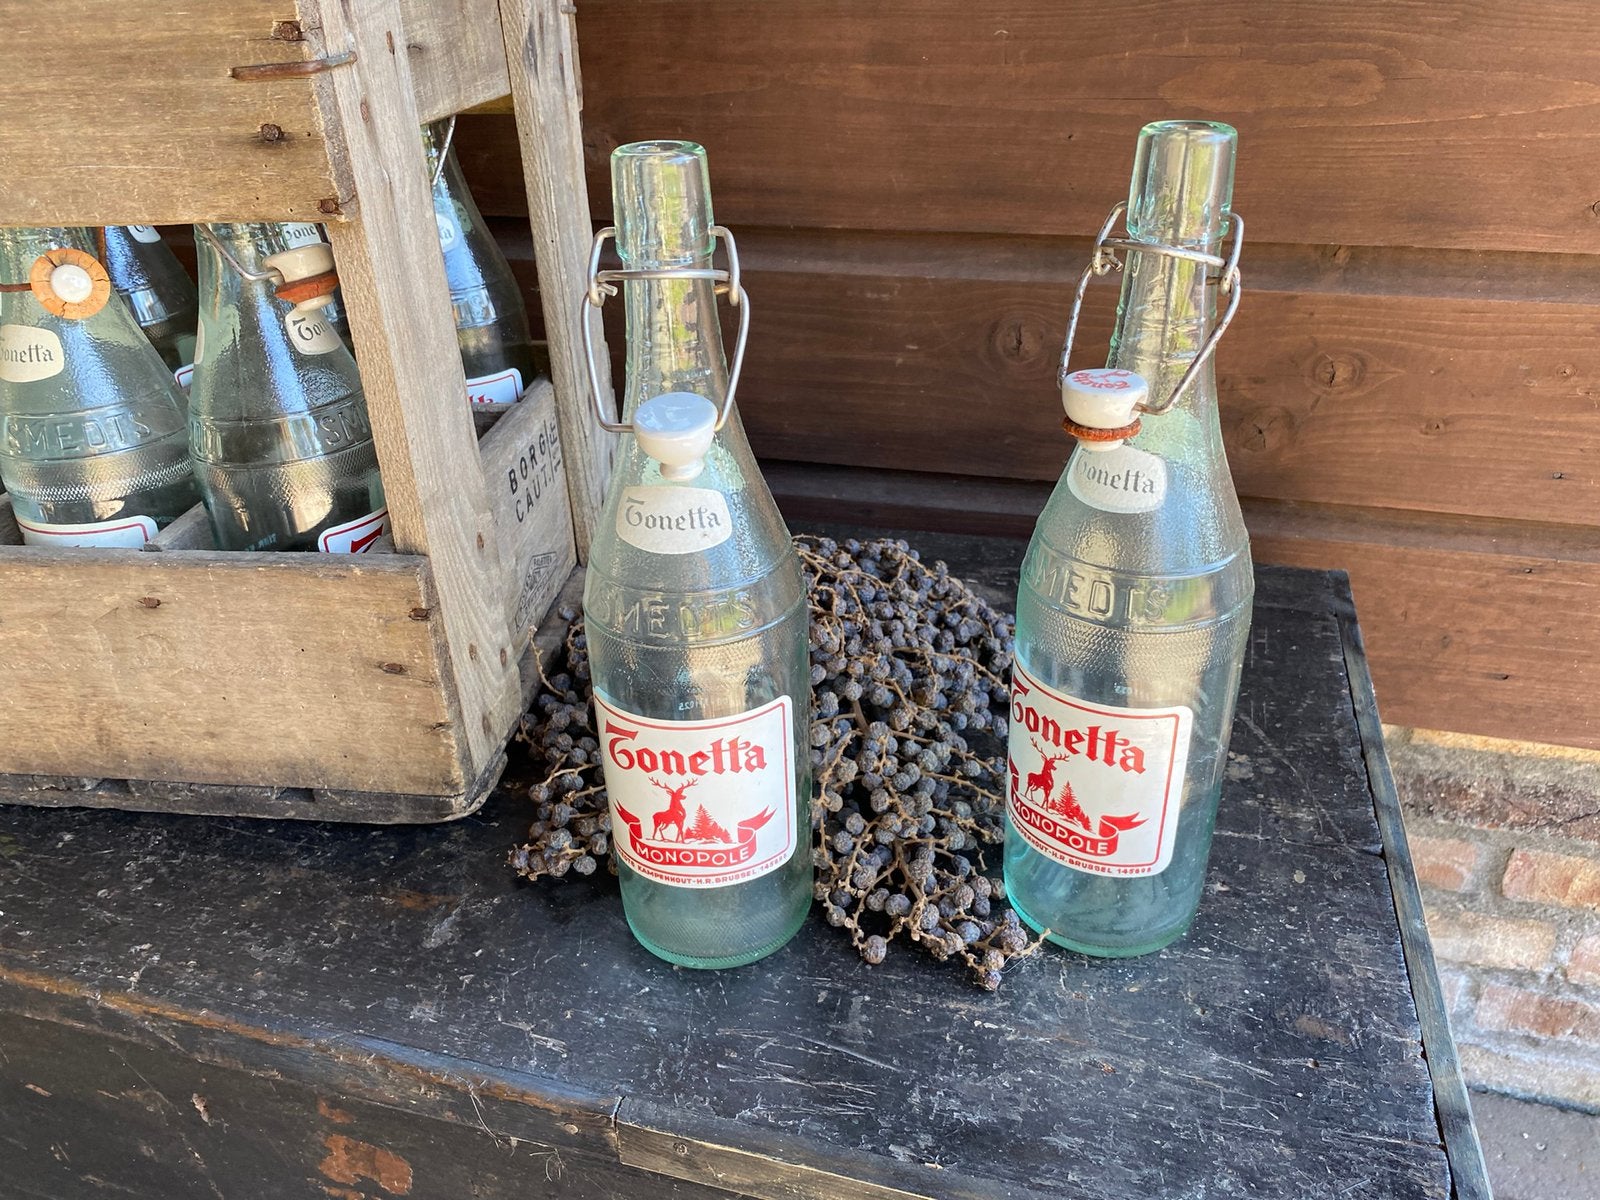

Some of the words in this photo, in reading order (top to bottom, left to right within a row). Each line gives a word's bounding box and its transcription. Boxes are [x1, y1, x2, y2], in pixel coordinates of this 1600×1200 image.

[1076, 448, 1154, 494] Tonetta
[625, 497, 722, 532] Tonetta
[1028, 555, 1169, 622] MEDTS
[605, 719, 768, 776] Tonetta
[1012, 675, 1146, 774] Tonetta
[635, 842, 750, 865] MONOPOLE
[1013, 797, 1109, 855] MONOPOLE
